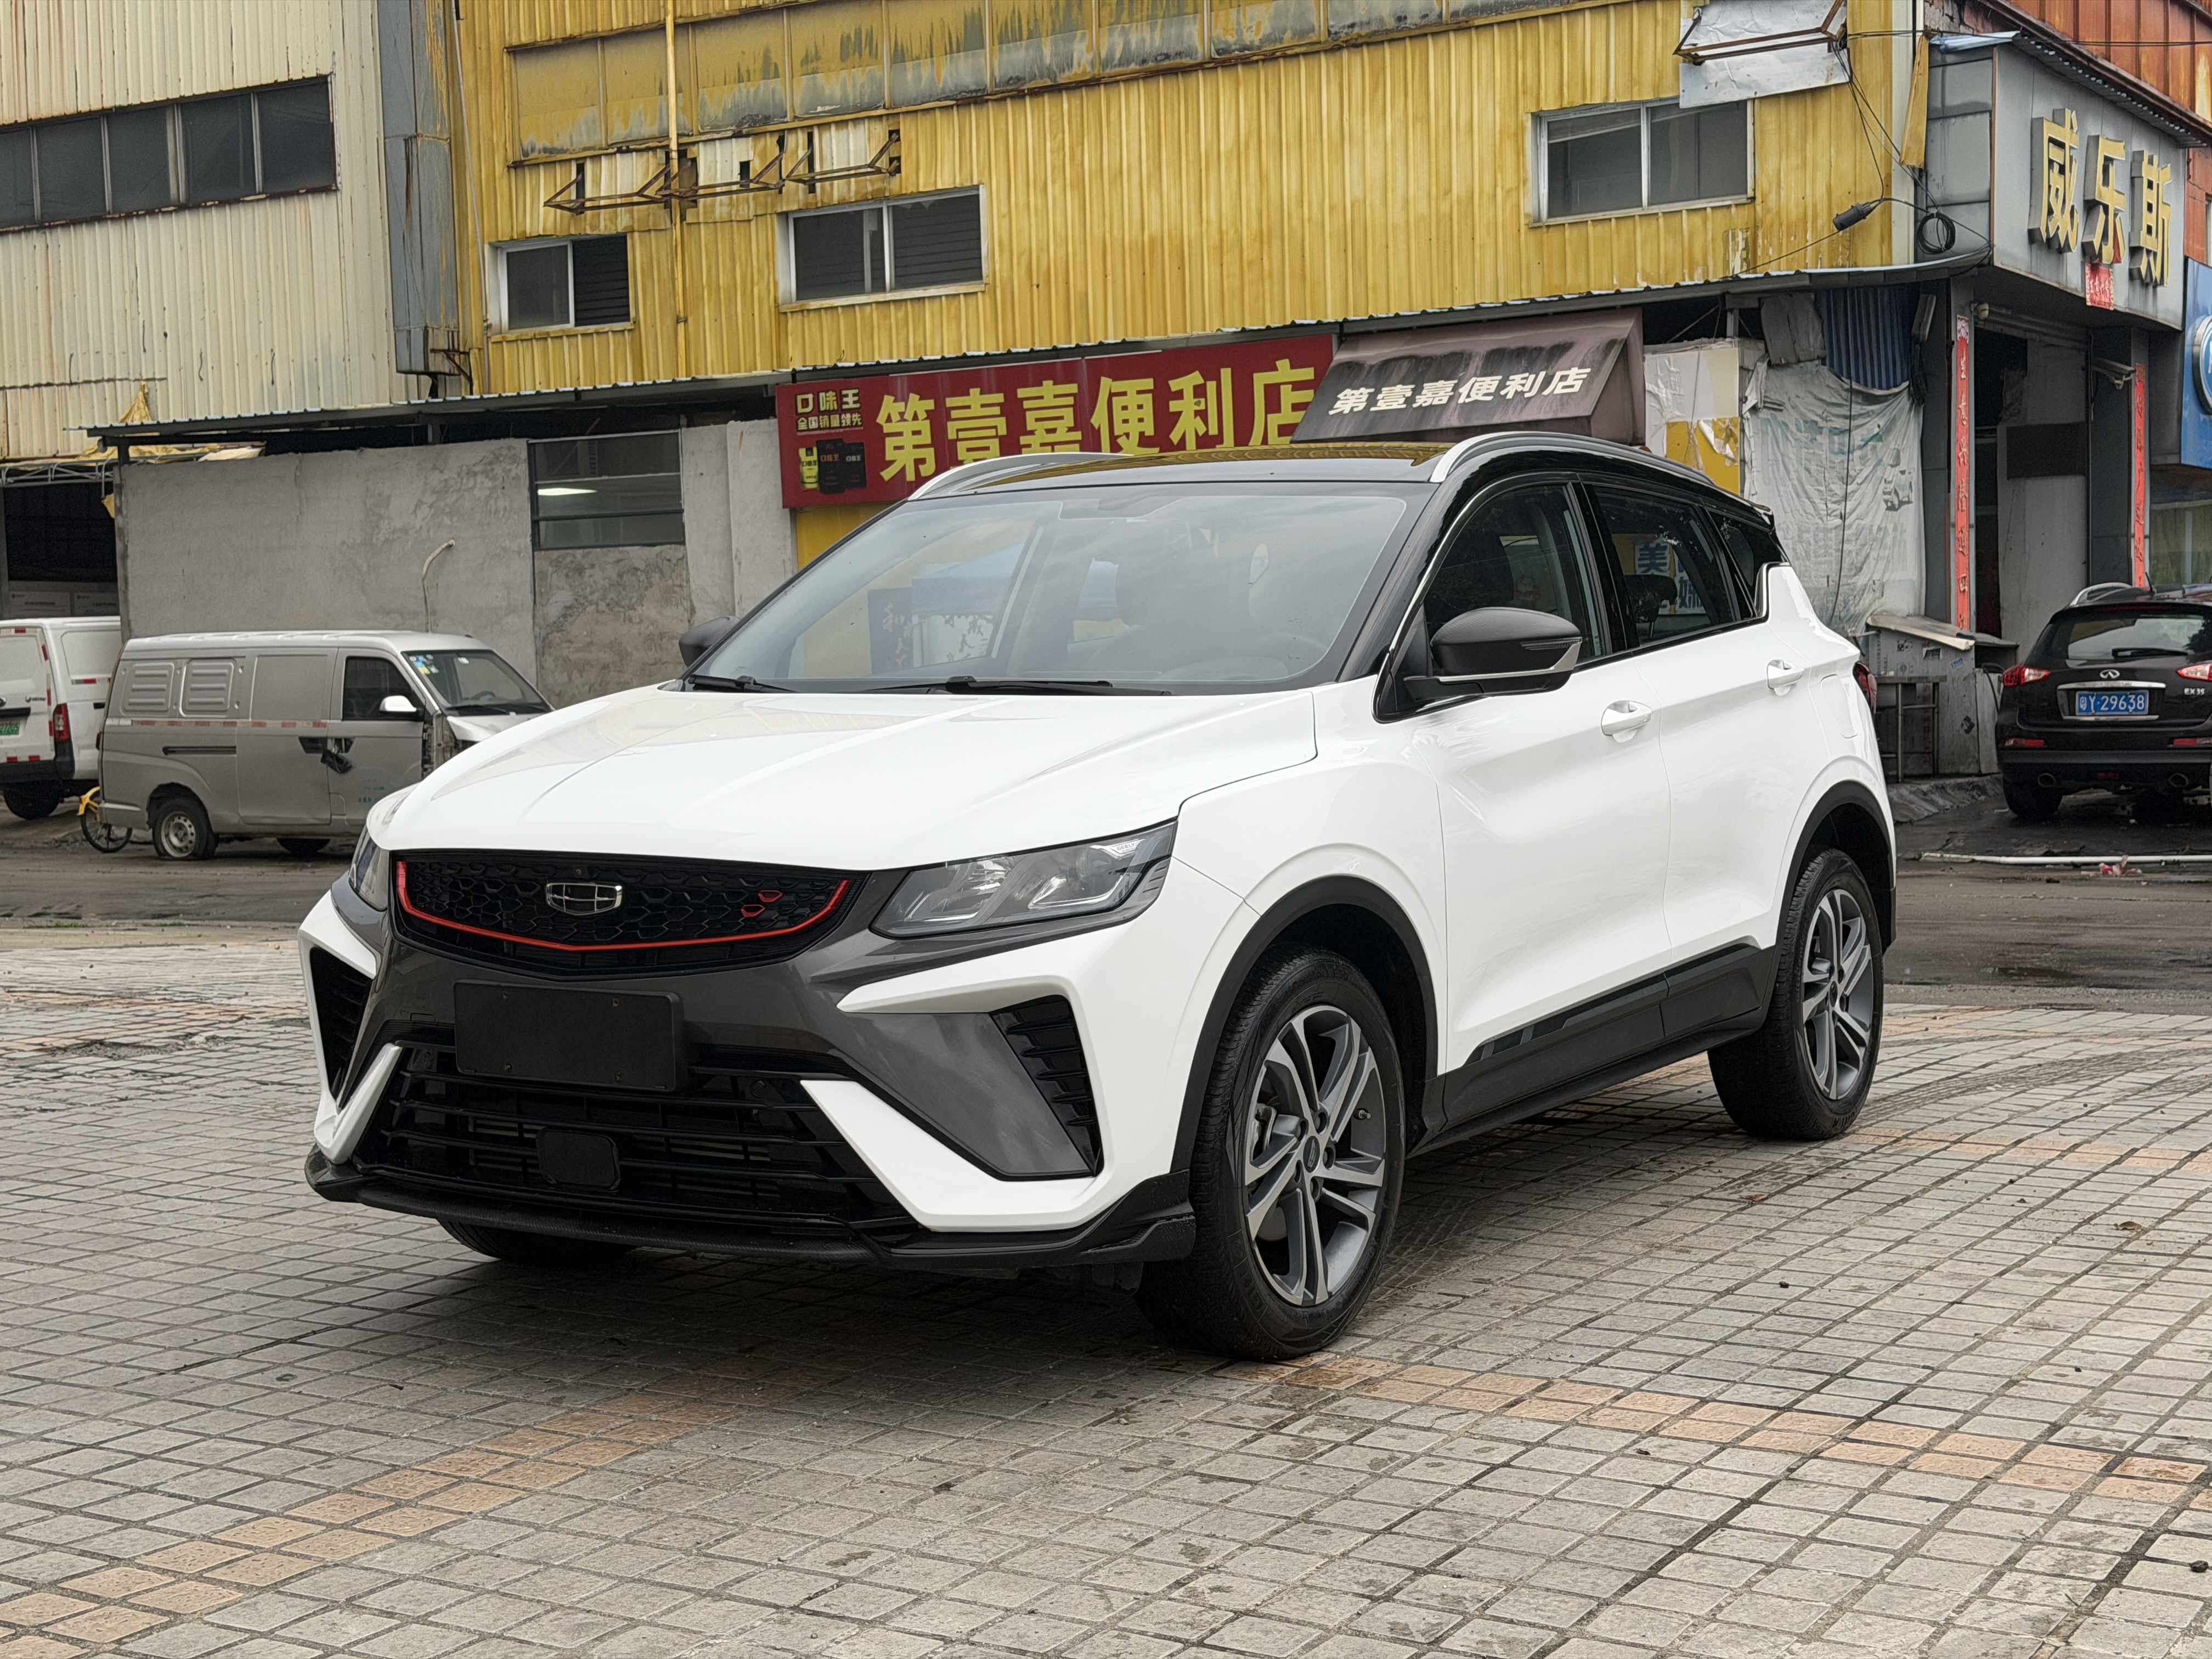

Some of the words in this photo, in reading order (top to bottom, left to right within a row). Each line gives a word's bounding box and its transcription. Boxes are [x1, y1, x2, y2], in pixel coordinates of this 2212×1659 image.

[2040, 108, 2171, 287] 威乐斯
[797, 389, 861, 414] 口味王
[1328, 367, 1591, 416] 第壹嘉便利店
[798, 413, 862, 431] 全国销量领先
[876, 359, 1314, 482] 第壹嘉便利店
[1116, 842, 1135, 850] GEELY
